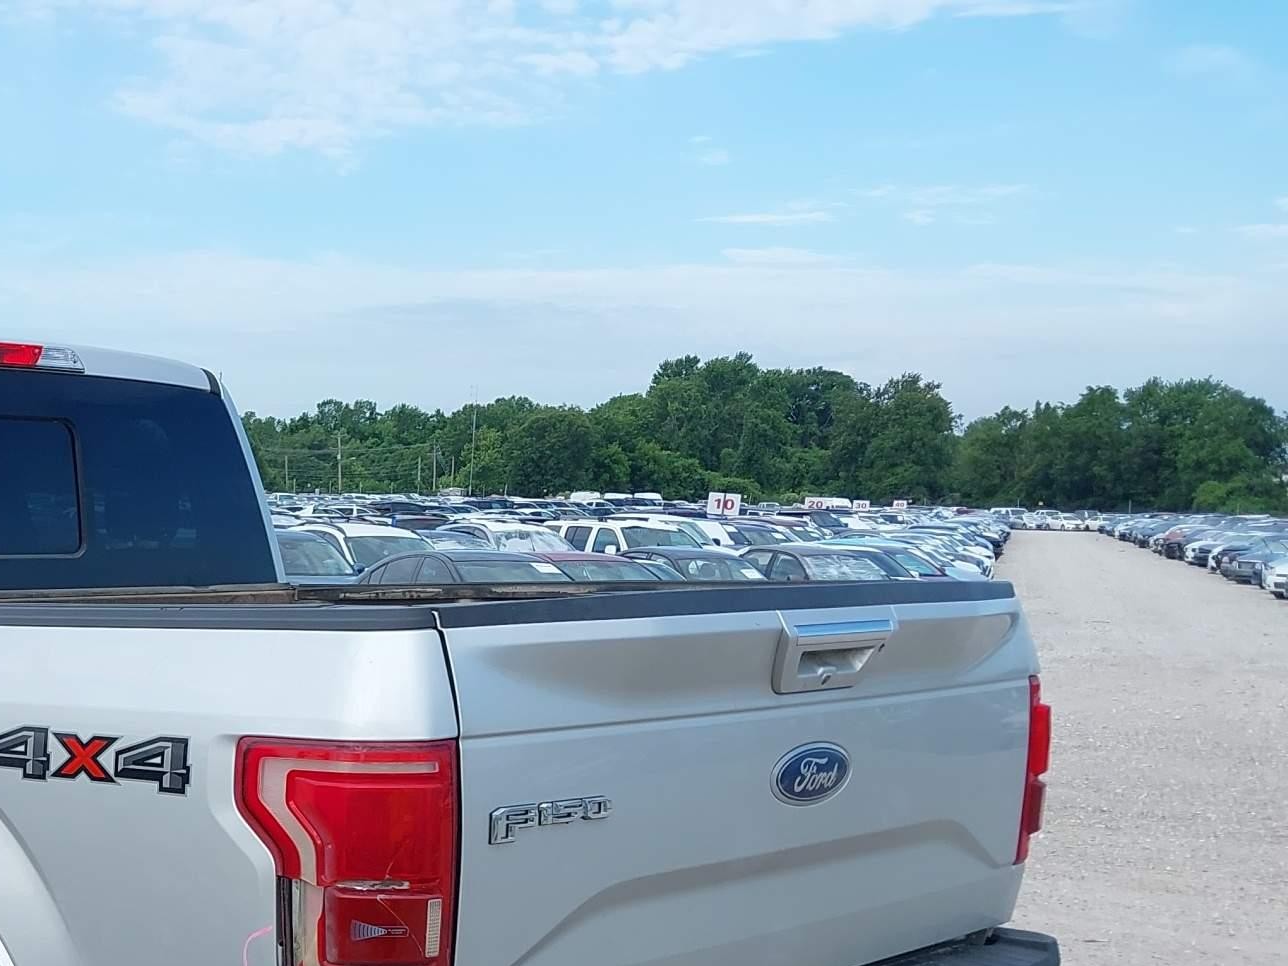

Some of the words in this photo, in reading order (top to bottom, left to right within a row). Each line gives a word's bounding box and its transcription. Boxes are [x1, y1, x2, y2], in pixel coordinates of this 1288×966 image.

[714, 498, 735, 510] 10
[808, 500, 823, 509] 20
[856, 502, 867, 510] 30
[794, 757, 838, 792] Ford
